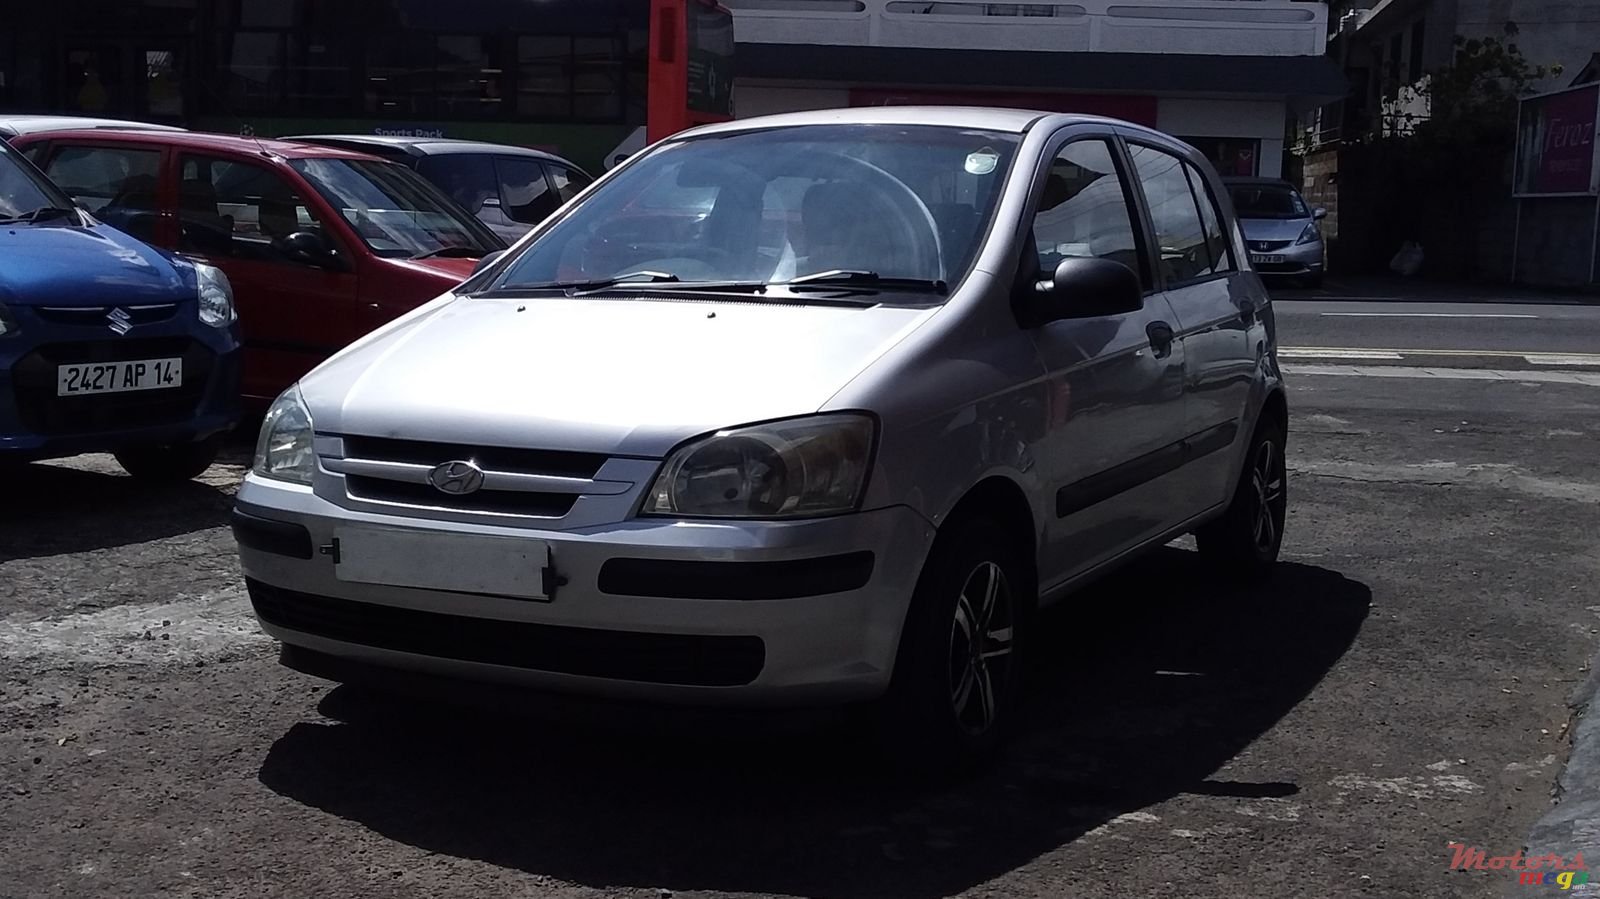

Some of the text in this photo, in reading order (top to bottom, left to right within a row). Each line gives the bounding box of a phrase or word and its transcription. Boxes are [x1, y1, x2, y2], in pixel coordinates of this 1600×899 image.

[1544, 118, 1592, 152] Feroz
[67, 361, 173, 391] 2427 AP 14
